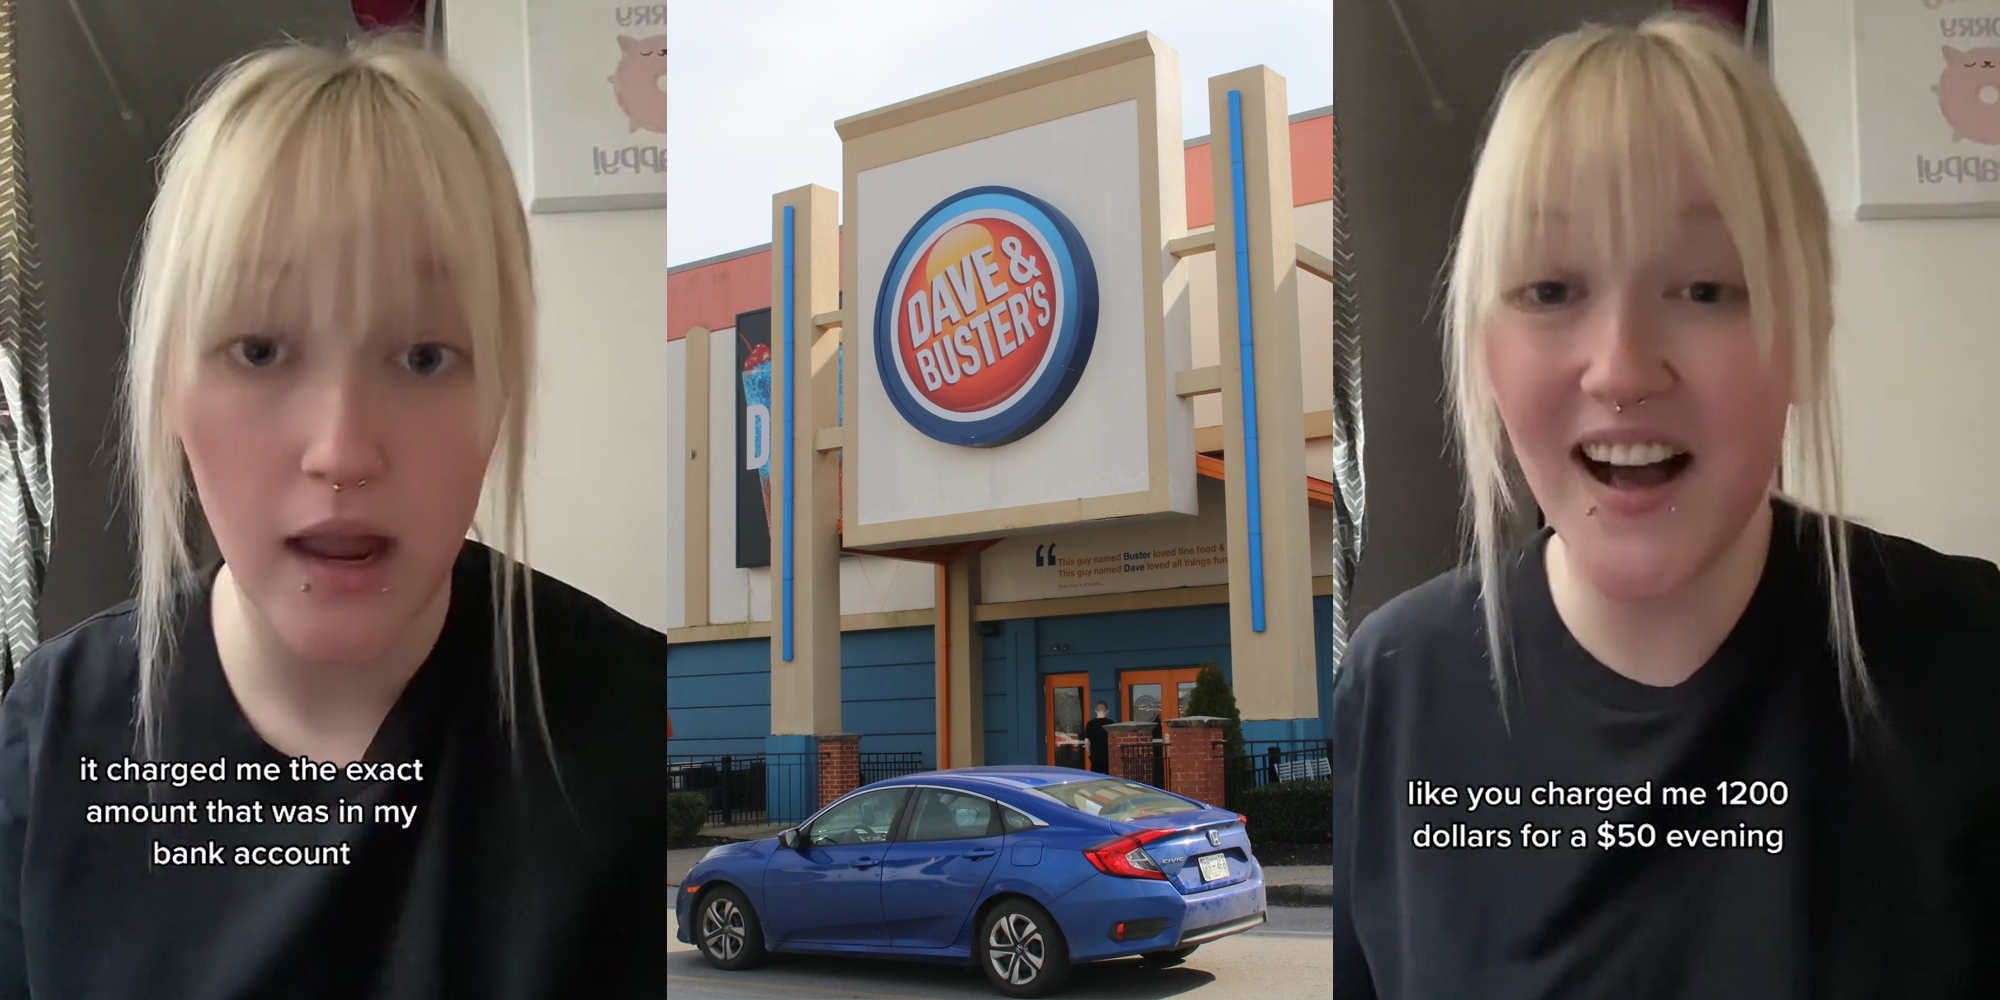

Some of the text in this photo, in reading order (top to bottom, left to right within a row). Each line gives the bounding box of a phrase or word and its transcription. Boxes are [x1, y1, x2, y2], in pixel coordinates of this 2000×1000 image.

[908, 236, 1042, 349] DAVE &
[916, 281, 1050, 392] BUSTER'S
[1058, 543, 1225, 566] This guy named Buster loved fine food &
[1058, 556, 1228, 578] This guy named Dave loved all things fun
